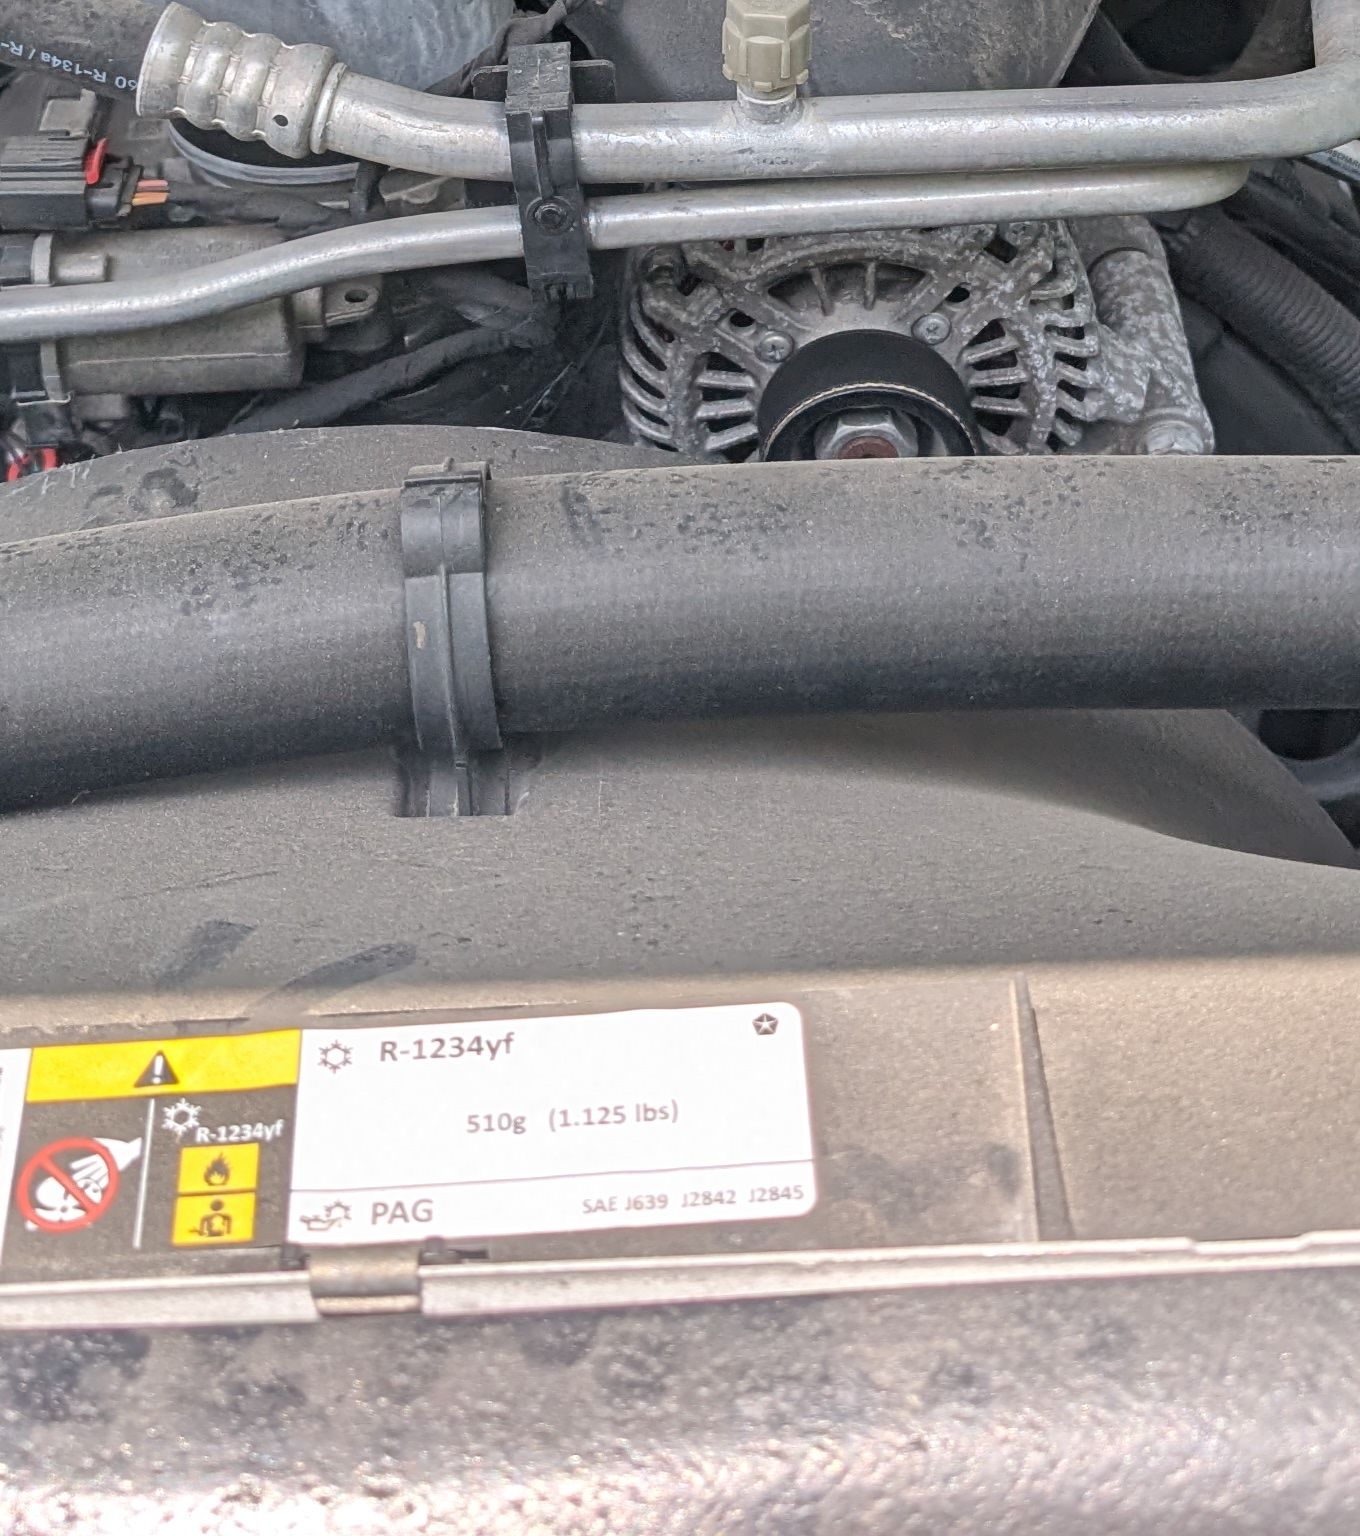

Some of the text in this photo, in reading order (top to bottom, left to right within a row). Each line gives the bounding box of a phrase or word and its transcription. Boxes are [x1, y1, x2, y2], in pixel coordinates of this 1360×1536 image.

[40, 51, 107, 83] R-134a
[379, 1032, 516, 1063] R-1234yf
[195, 1119, 285, 1143] R-1234yf
[466, 1098, 681, 1136] 510g (1.125 lbs)
[371, 1198, 434, 1225] PAG
[582, 1184, 805, 1214] SAE J639 J2842 J2845
